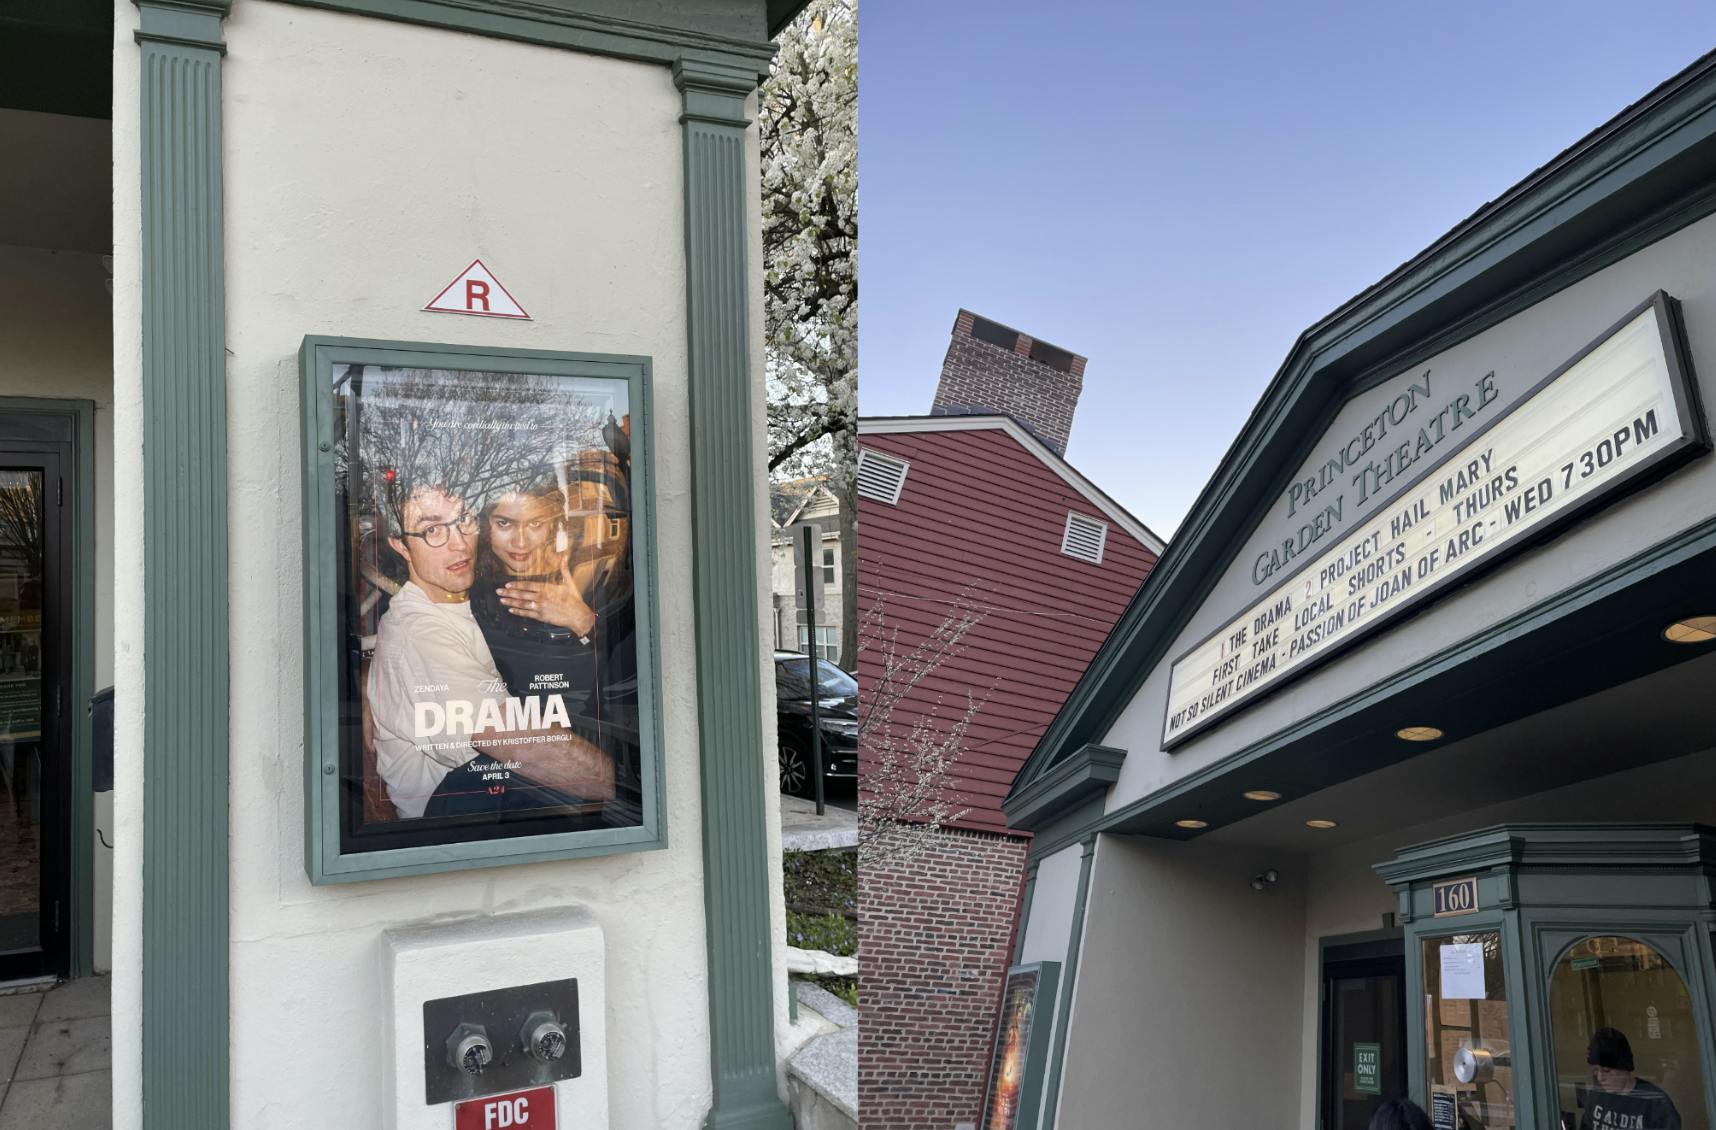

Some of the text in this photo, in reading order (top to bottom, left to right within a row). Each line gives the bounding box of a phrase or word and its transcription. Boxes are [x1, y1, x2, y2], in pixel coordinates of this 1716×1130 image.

[466, 279, 490, 311] R
[1287, 368, 1431, 519] PRINCETON
[1252, 370, 1500, 586] GARDEN THEATRE
[1229, 626, 1247, 652] THE
[1254, 596, 1292, 636] DRAMA
[1305, 580, 1312, 599] 2
[1320, 530, 1380, 590] PROJECT
[1390, 498, 1430, 539] HAIL
[1439, 448, 1493, 505] MARY
[1212, 653, 1241, 686] FIRST
[1252, 627, 1279, 659] TAKE
[1294, 593, 1333, 632] LOCAL
[1348, 541, 1405, 597] SHORTS
[1453, 465, 1518, 526] THURS
[1169, 707, 1187, 732] NOT
[1186, 701, 1199, 722] SO
[1200, 679, 1234, 714] SILENT
[1235, 652, 1276, 692] CINEMA
[1289, 609, 1345, 659] PASSION
[1347, 595, 1366, 623] OF
[1370, 565, 1412, 609] JOAN
[1418, 548, 1439, 580] OF
[1445, 520, 1484, 563] ARC
[1504, 477, 1553, 525] WED
[413, 683, 449, 694] ZENDAYA
[477, 677, 509, 694] The
[529, 681, 570, 690] PATTINSON
[534, 673, 563, 682] ROBERT
[414, 693, 572, 738] DRAMA
[415, 742, 450, 752] WRITTEN
[455, 739, 492, 749] DIRECTED
[493, 739, 501, 747] BY
[502, 735, 546, 746] KRISTOFFER
[547, 734, 572, 743] BORGLI
[467, 759, 523, 773] Save the date
[482, 772, 504, 780] APRIL
[1438, 883, 1470, 912] 160
[1357, 1064, 1377, 1075] ONLY
[1359, 1052, 1375, 1064] EXIT
[485, 1097, 529, 1130] FDC
